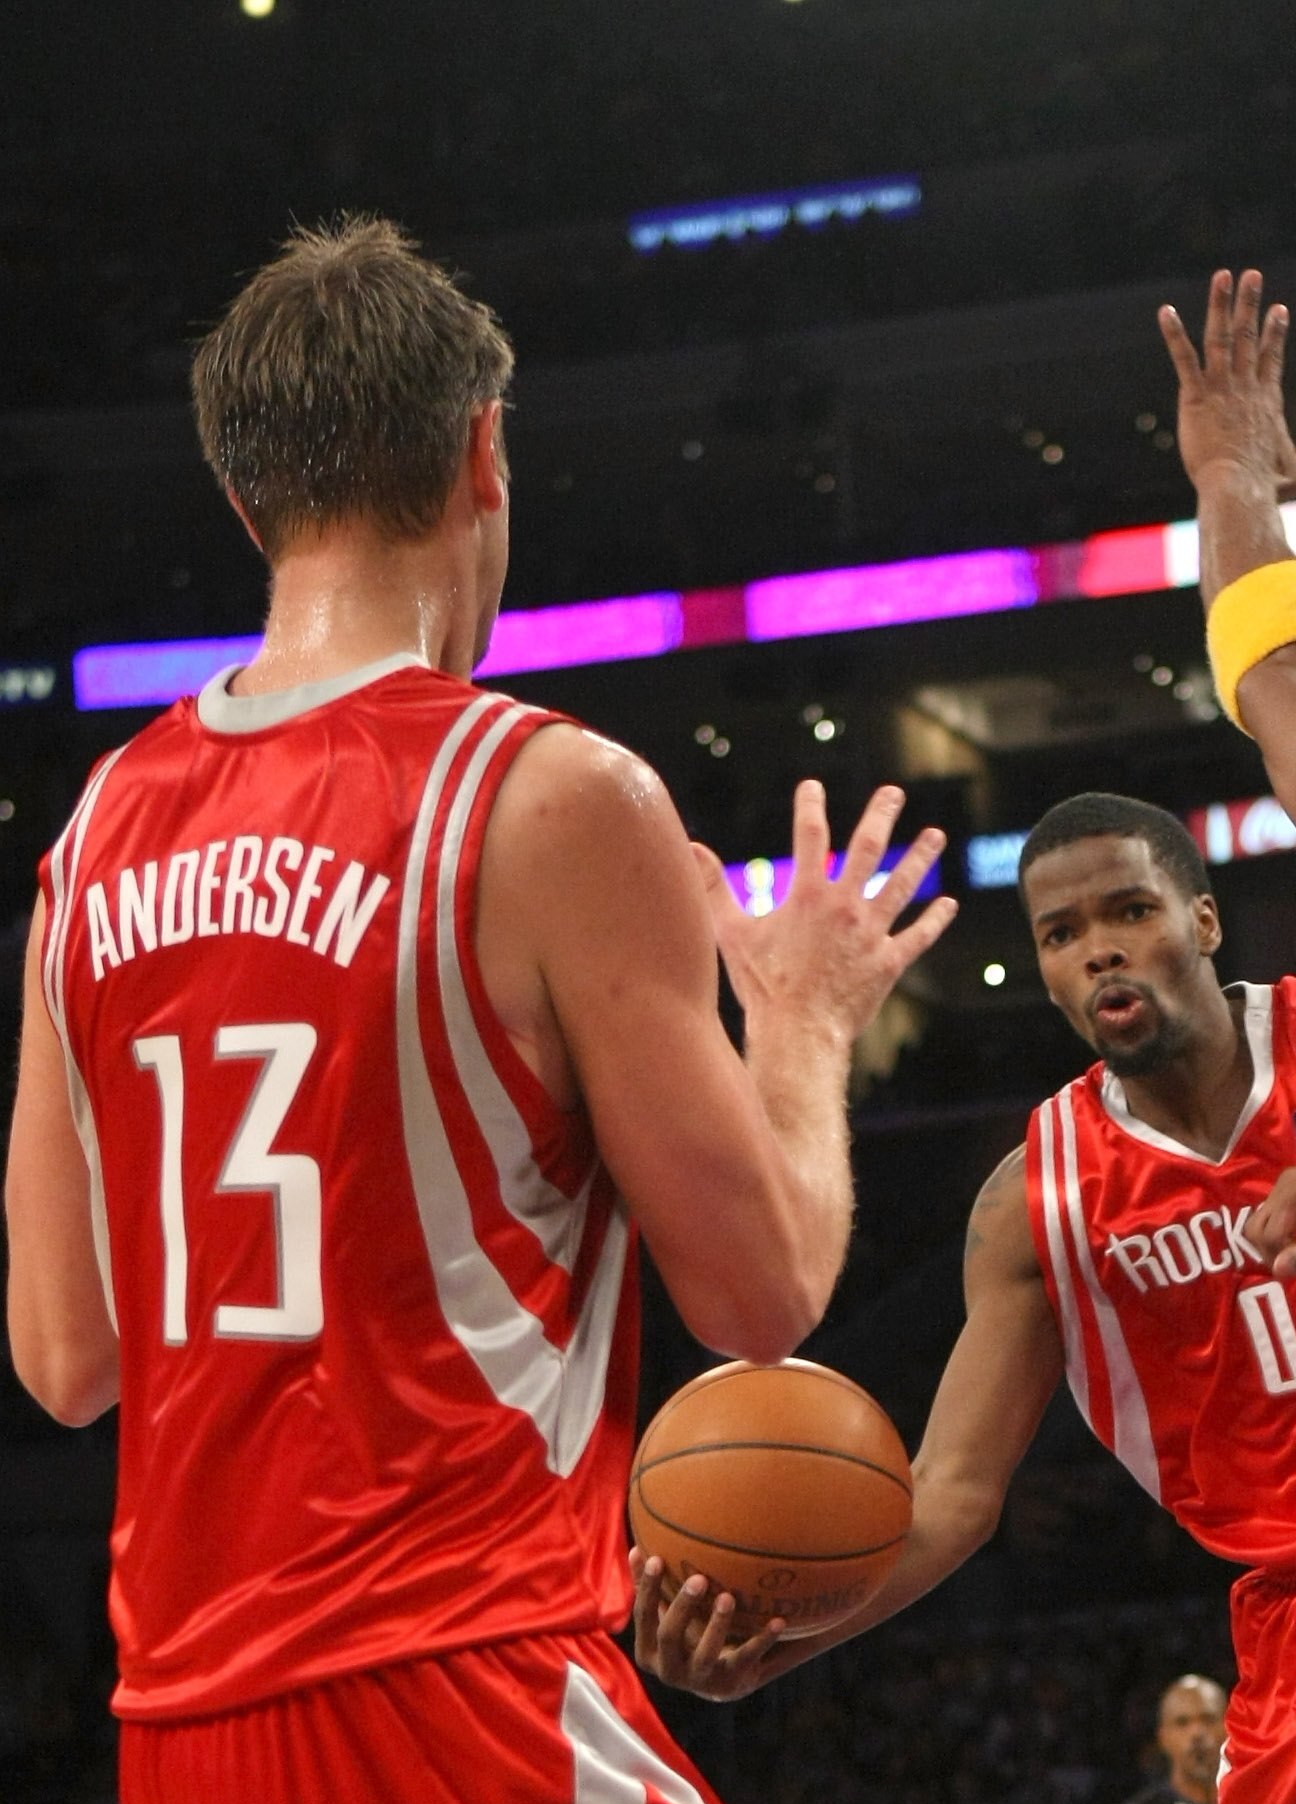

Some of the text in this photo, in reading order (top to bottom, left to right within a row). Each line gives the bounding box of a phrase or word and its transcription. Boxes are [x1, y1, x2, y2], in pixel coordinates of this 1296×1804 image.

[85, 834, 391, 983] ANDERSEN
[131, 1021, 325, 1348] 13
[1105, 1204, 1264, 1293] ROCK
